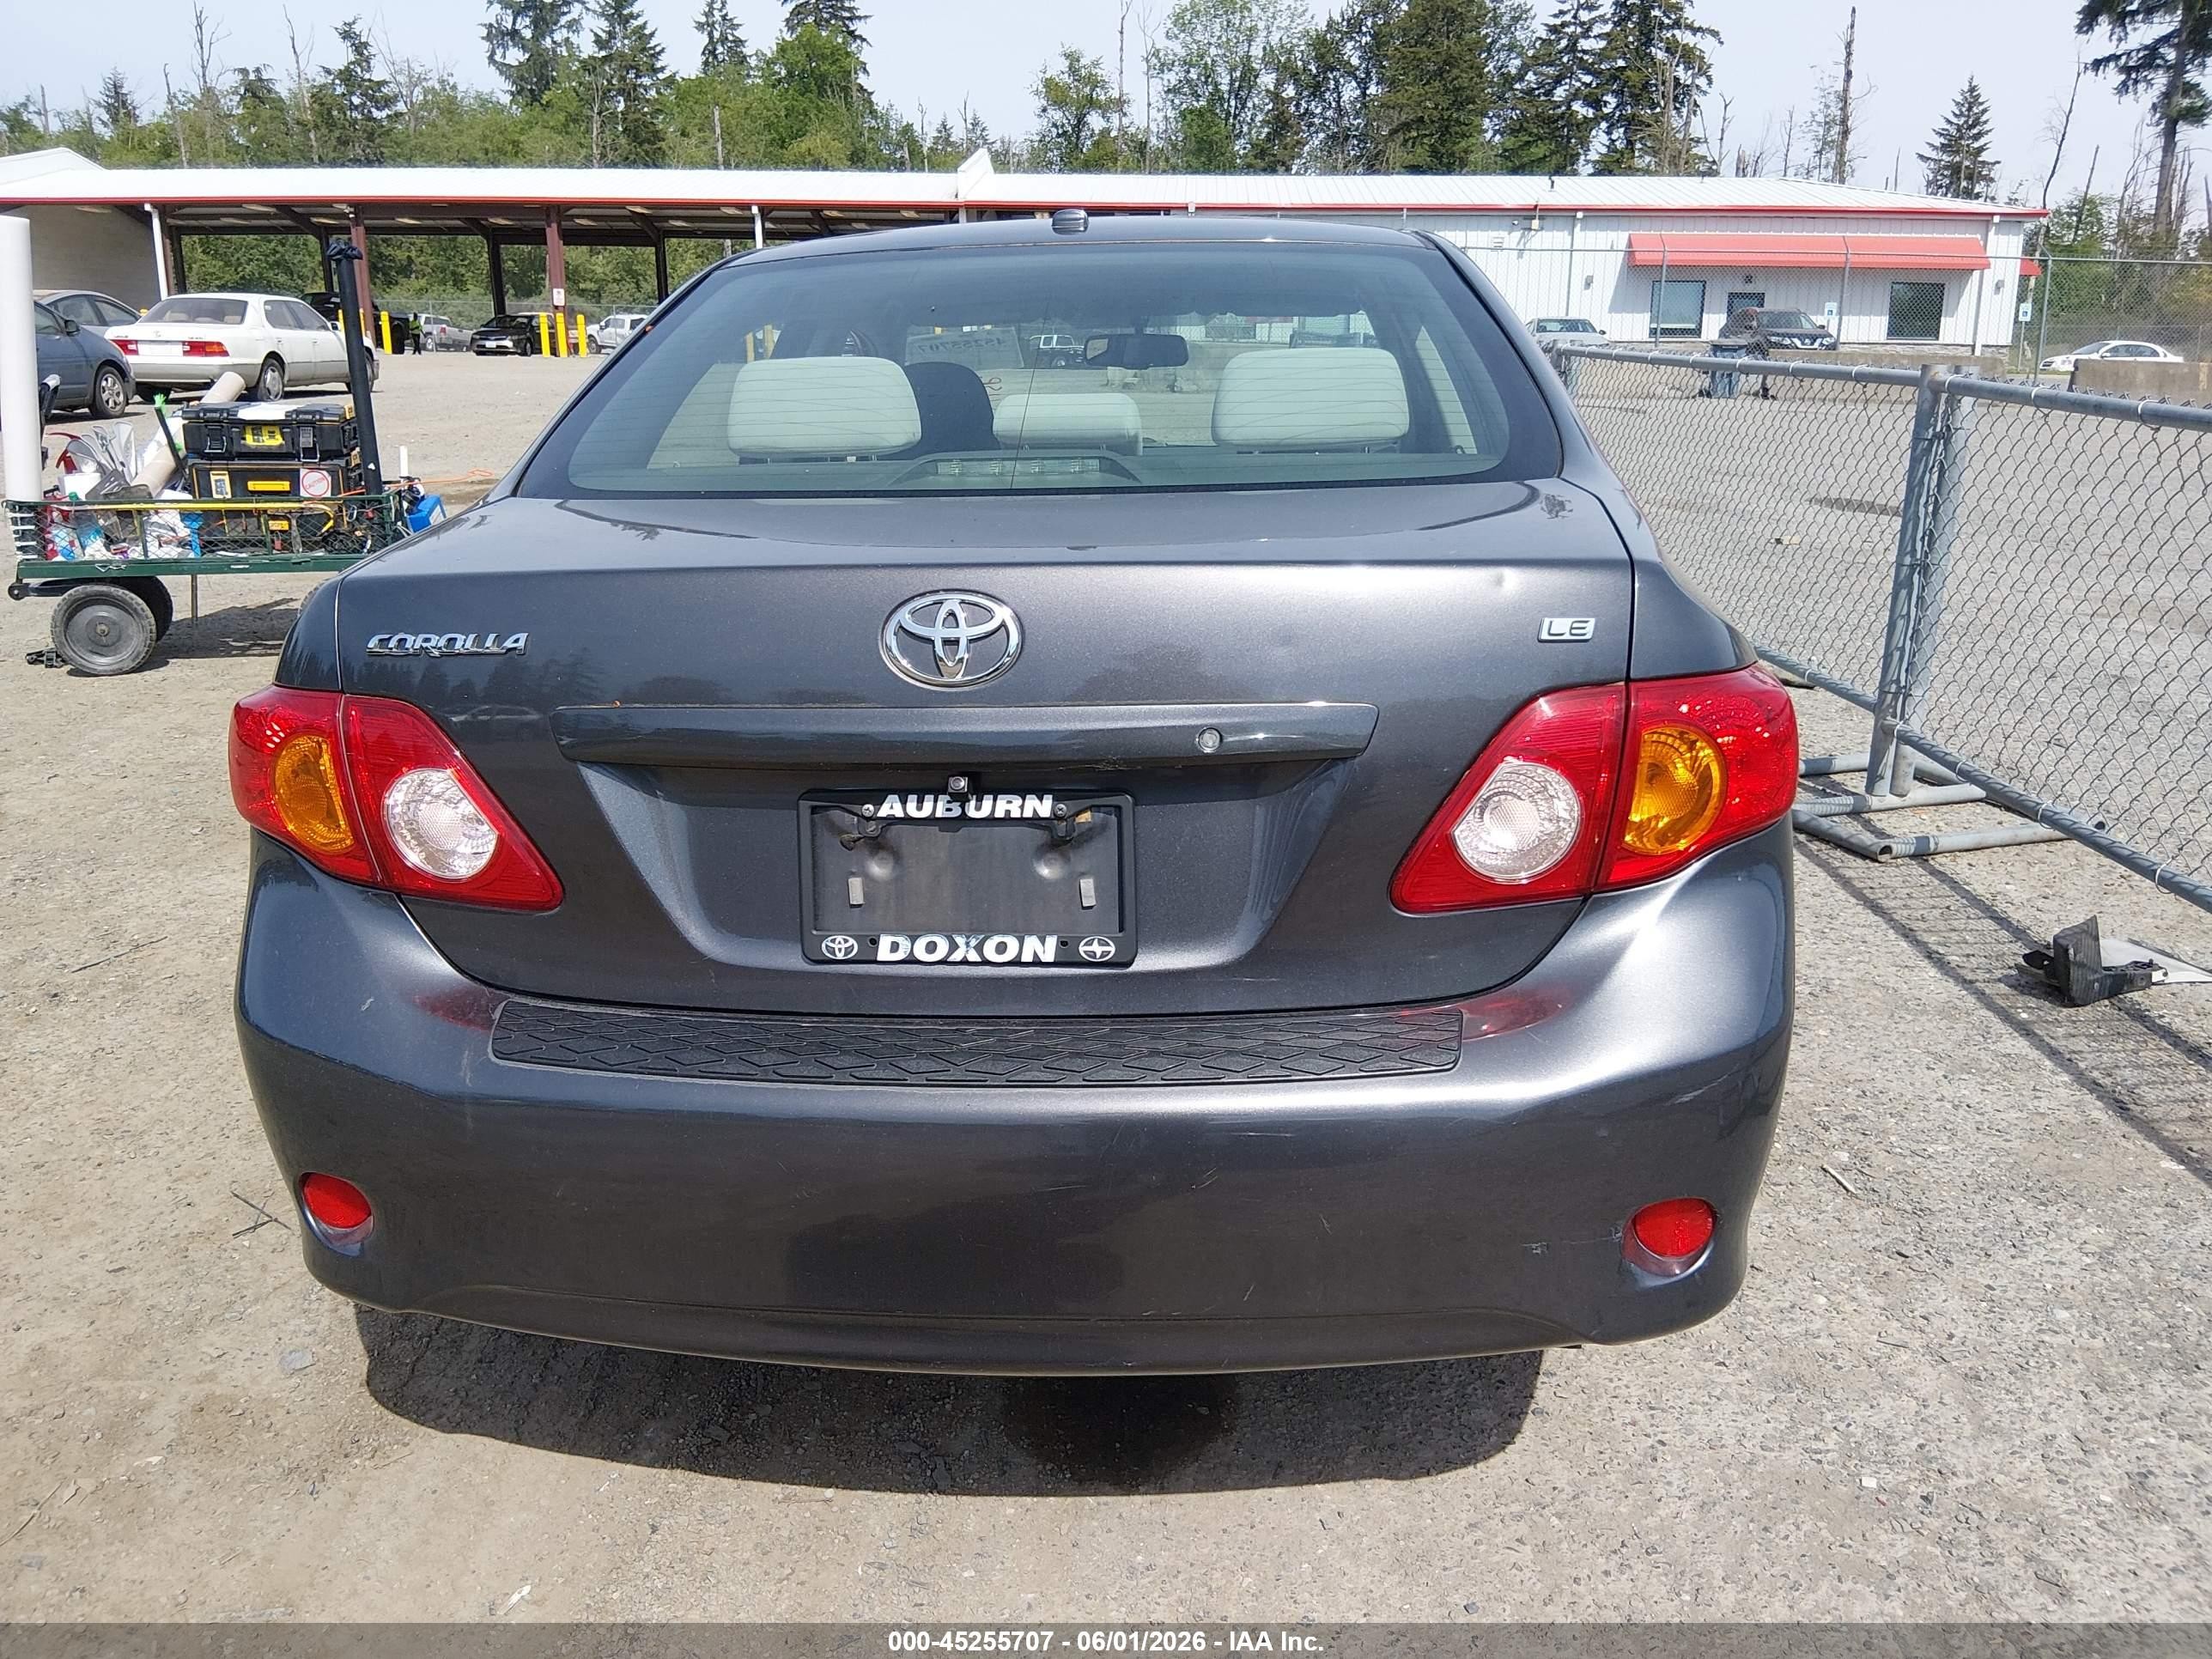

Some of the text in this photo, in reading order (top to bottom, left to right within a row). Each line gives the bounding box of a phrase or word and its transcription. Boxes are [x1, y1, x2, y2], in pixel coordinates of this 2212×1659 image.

[1545, 618, 1591, 638] LE
[366, 632, 529, 657] COROLLA
[876, 793, 1054, 818] AUBURN
[876, 933, 1058, 963] DOXON
